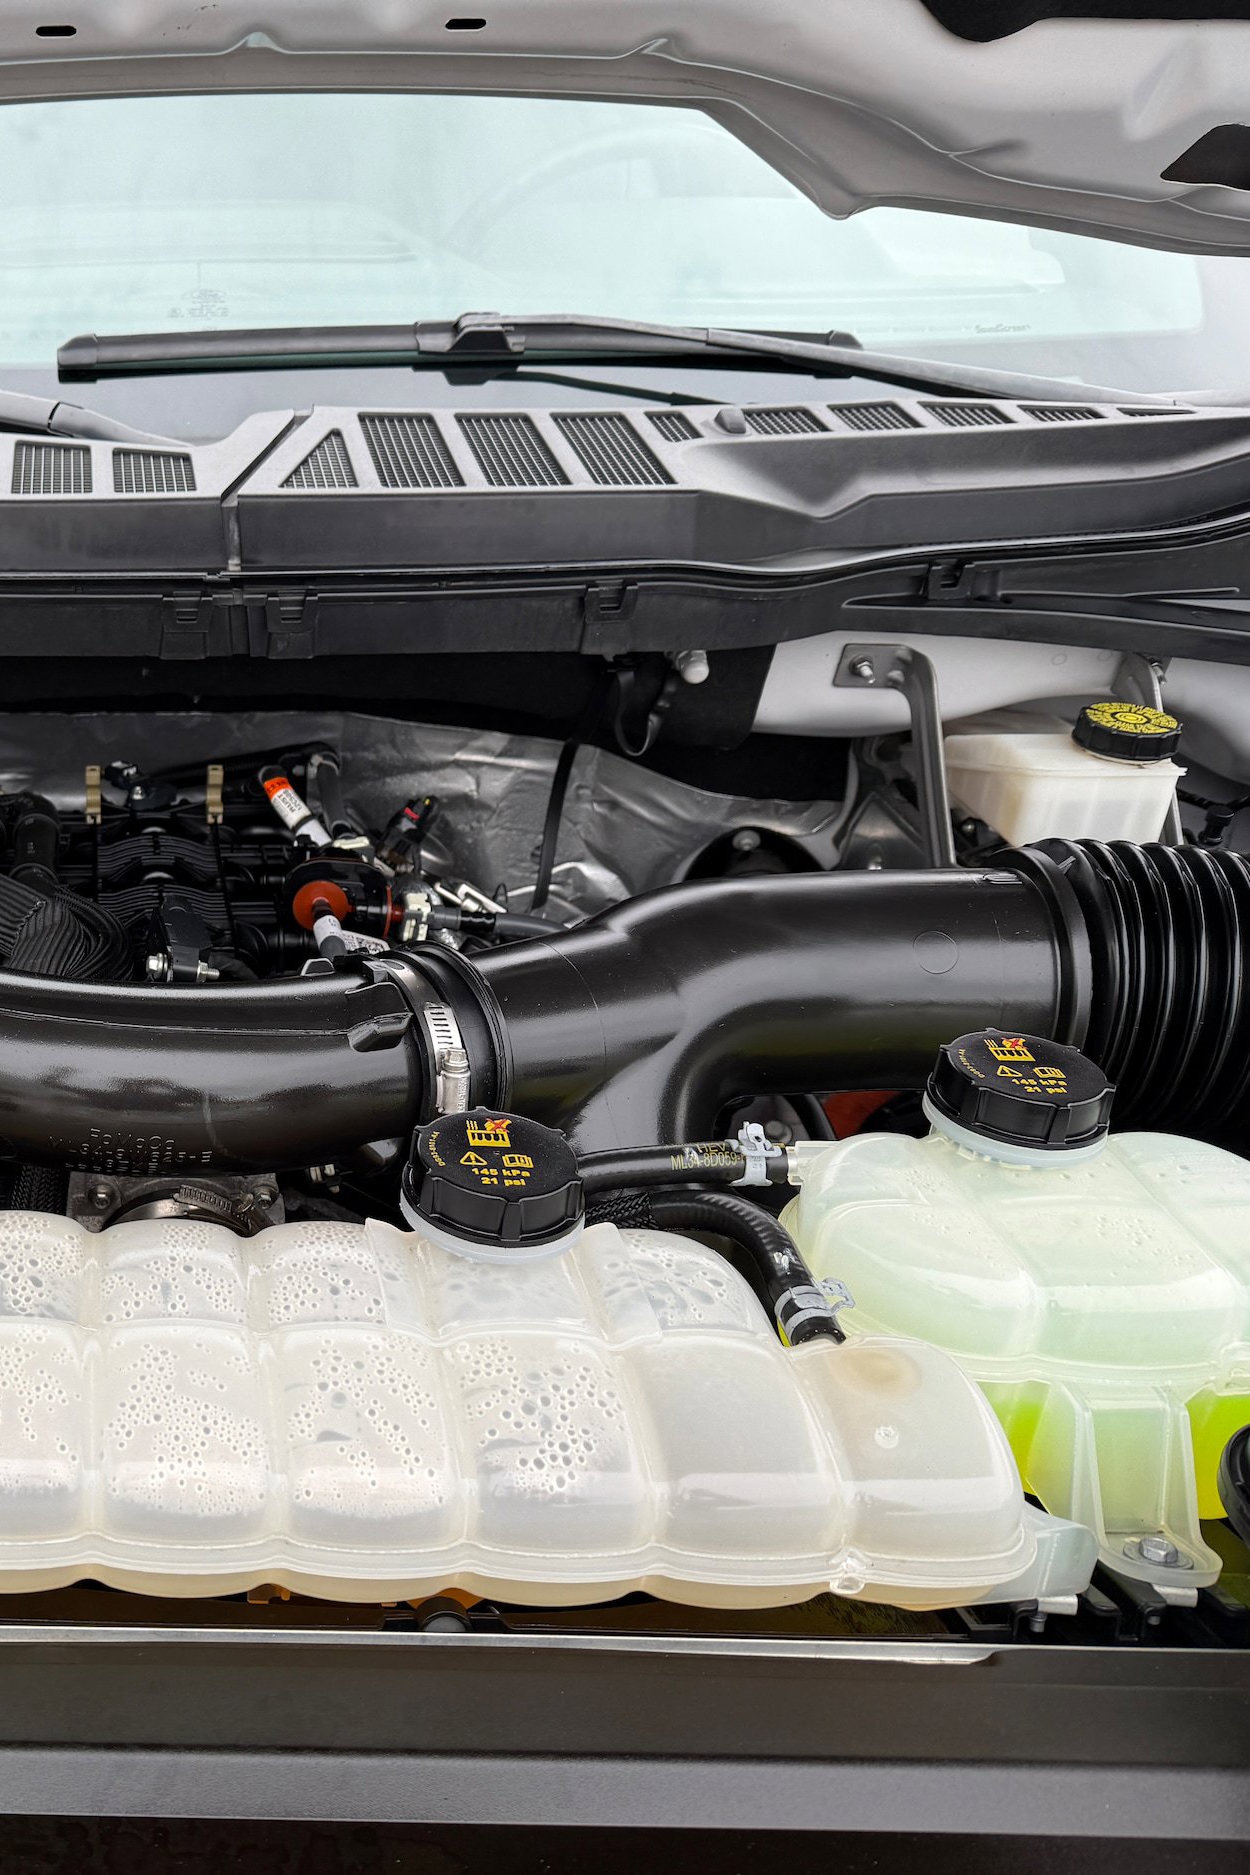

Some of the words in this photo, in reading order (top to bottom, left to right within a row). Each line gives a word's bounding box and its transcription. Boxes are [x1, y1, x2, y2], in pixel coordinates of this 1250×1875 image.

[696, 1142, 726, 1153] HEV
[471, 1167, 498, 1176] 145
[501, 1168, 531, 1177] kPa
[480, 1177, 499, 1185] 21
[503, 1179, 526, 1187] psi
